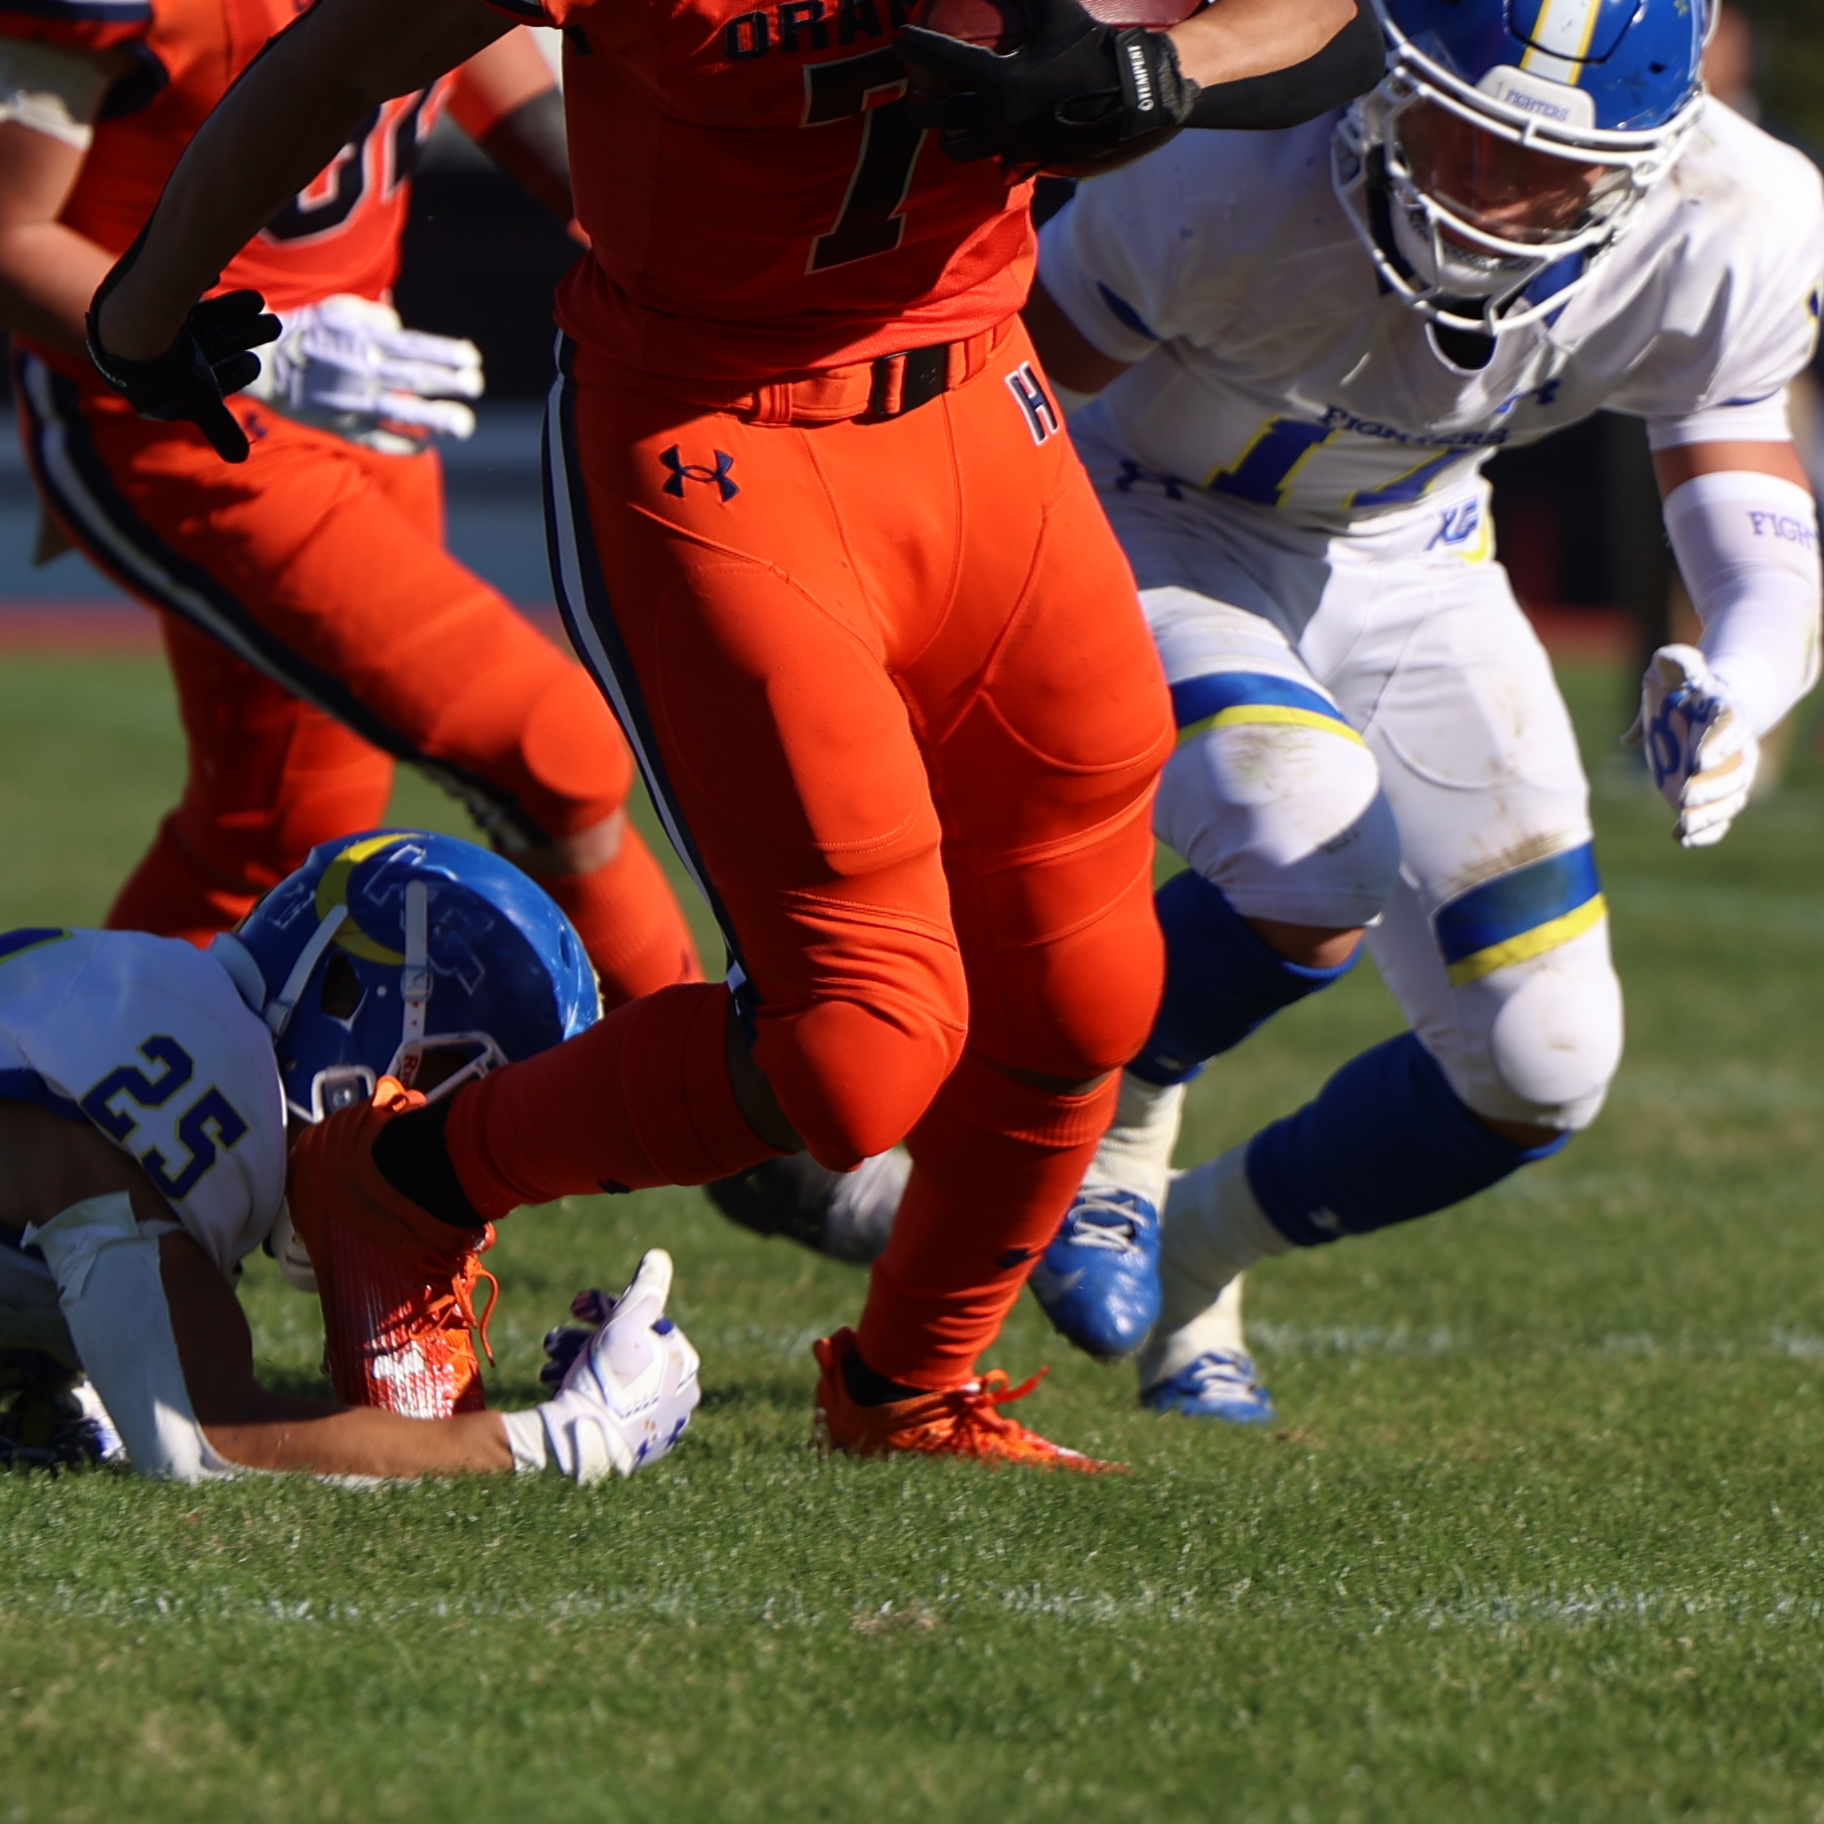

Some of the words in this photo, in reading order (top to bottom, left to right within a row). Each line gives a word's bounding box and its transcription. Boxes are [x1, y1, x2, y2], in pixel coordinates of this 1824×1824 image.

[799, 43, 929, 276] 7
[1005, 360, 1059, 446] H
[79, 1034, 250, 1202] 25
